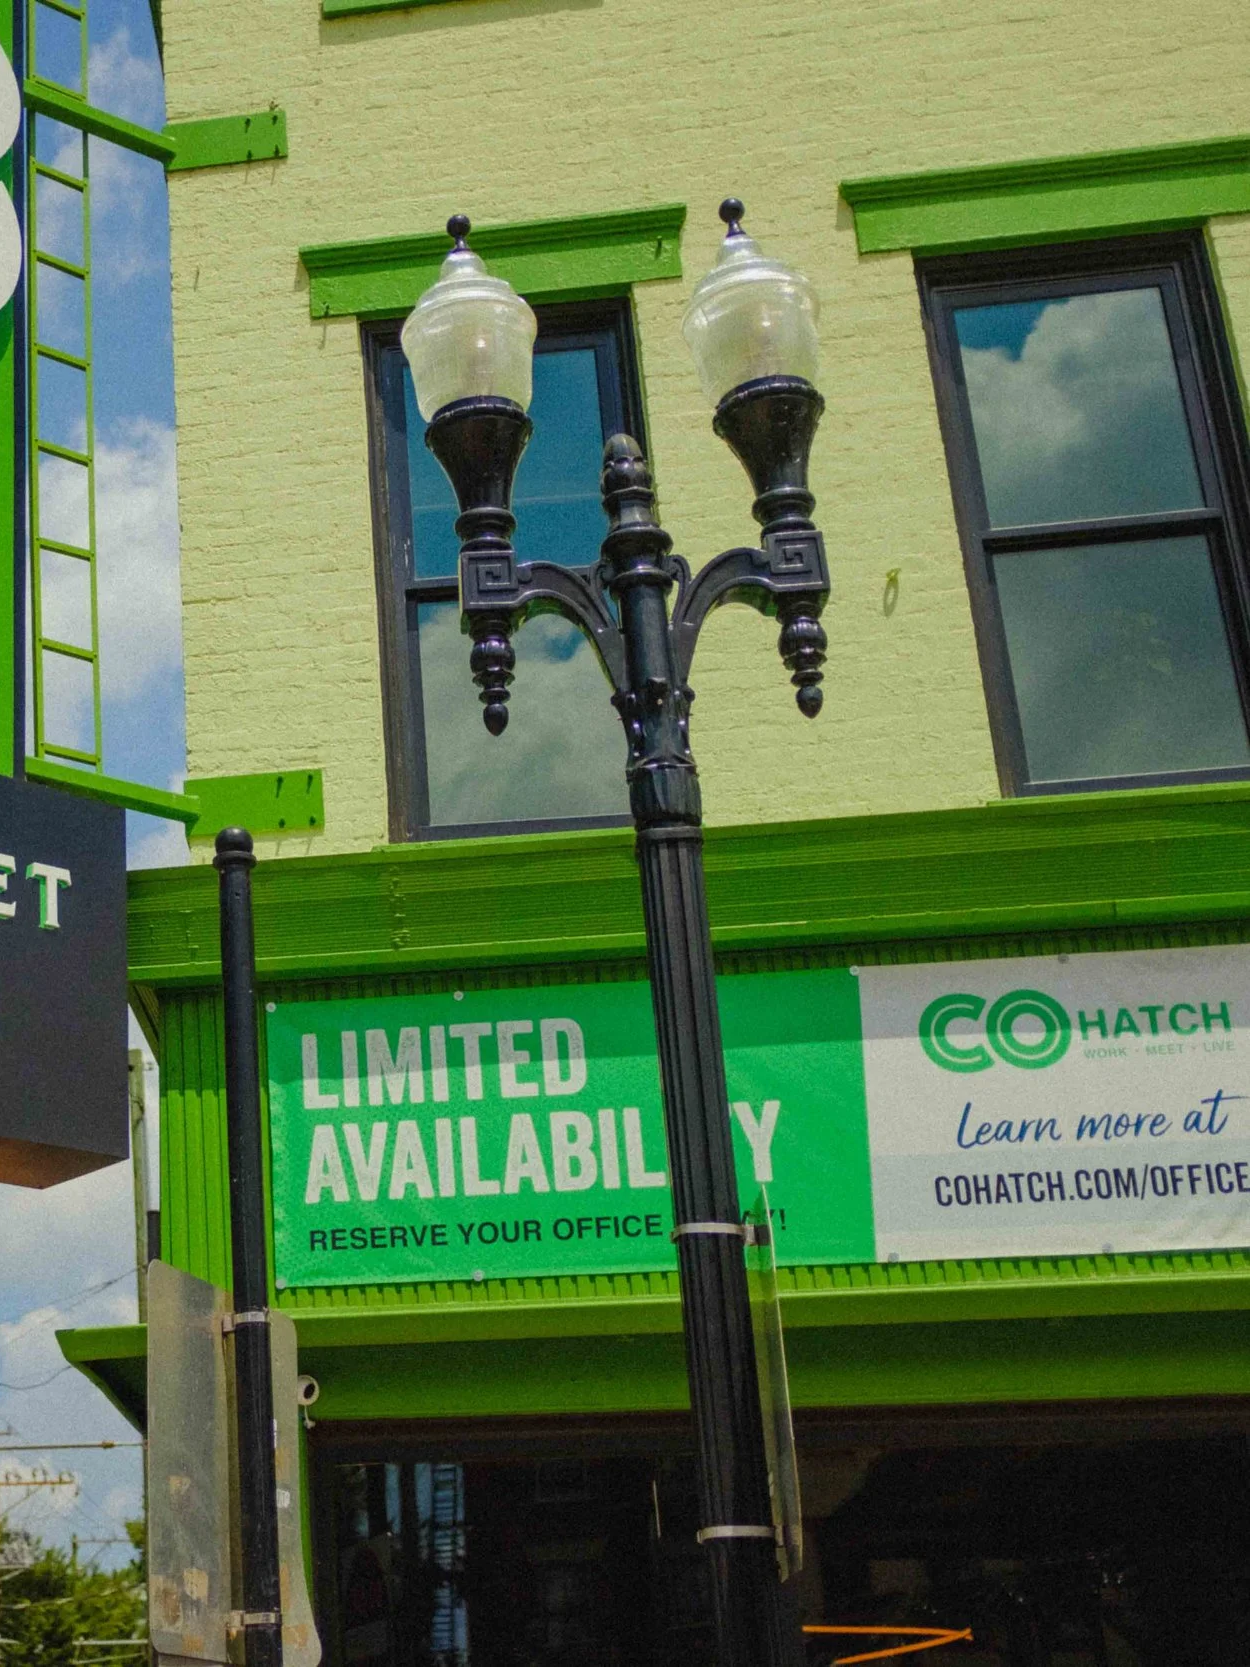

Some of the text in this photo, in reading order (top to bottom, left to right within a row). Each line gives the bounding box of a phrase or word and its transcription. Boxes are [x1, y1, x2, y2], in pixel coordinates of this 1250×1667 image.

[301, 1017, 588, 1110] LIMITED
[1083, 1040, 1236, 1059] WORK MEET LIVE
[956, 1088, 1250, 1149] Learn more at
[305, 1099, 781, 1204] AVAILABILY
[934, 1161, 1250, 1207] COHATCH.COM/OFFICE
[309, 1213, 663, 1252] RESERVE YOUR OFFICE
